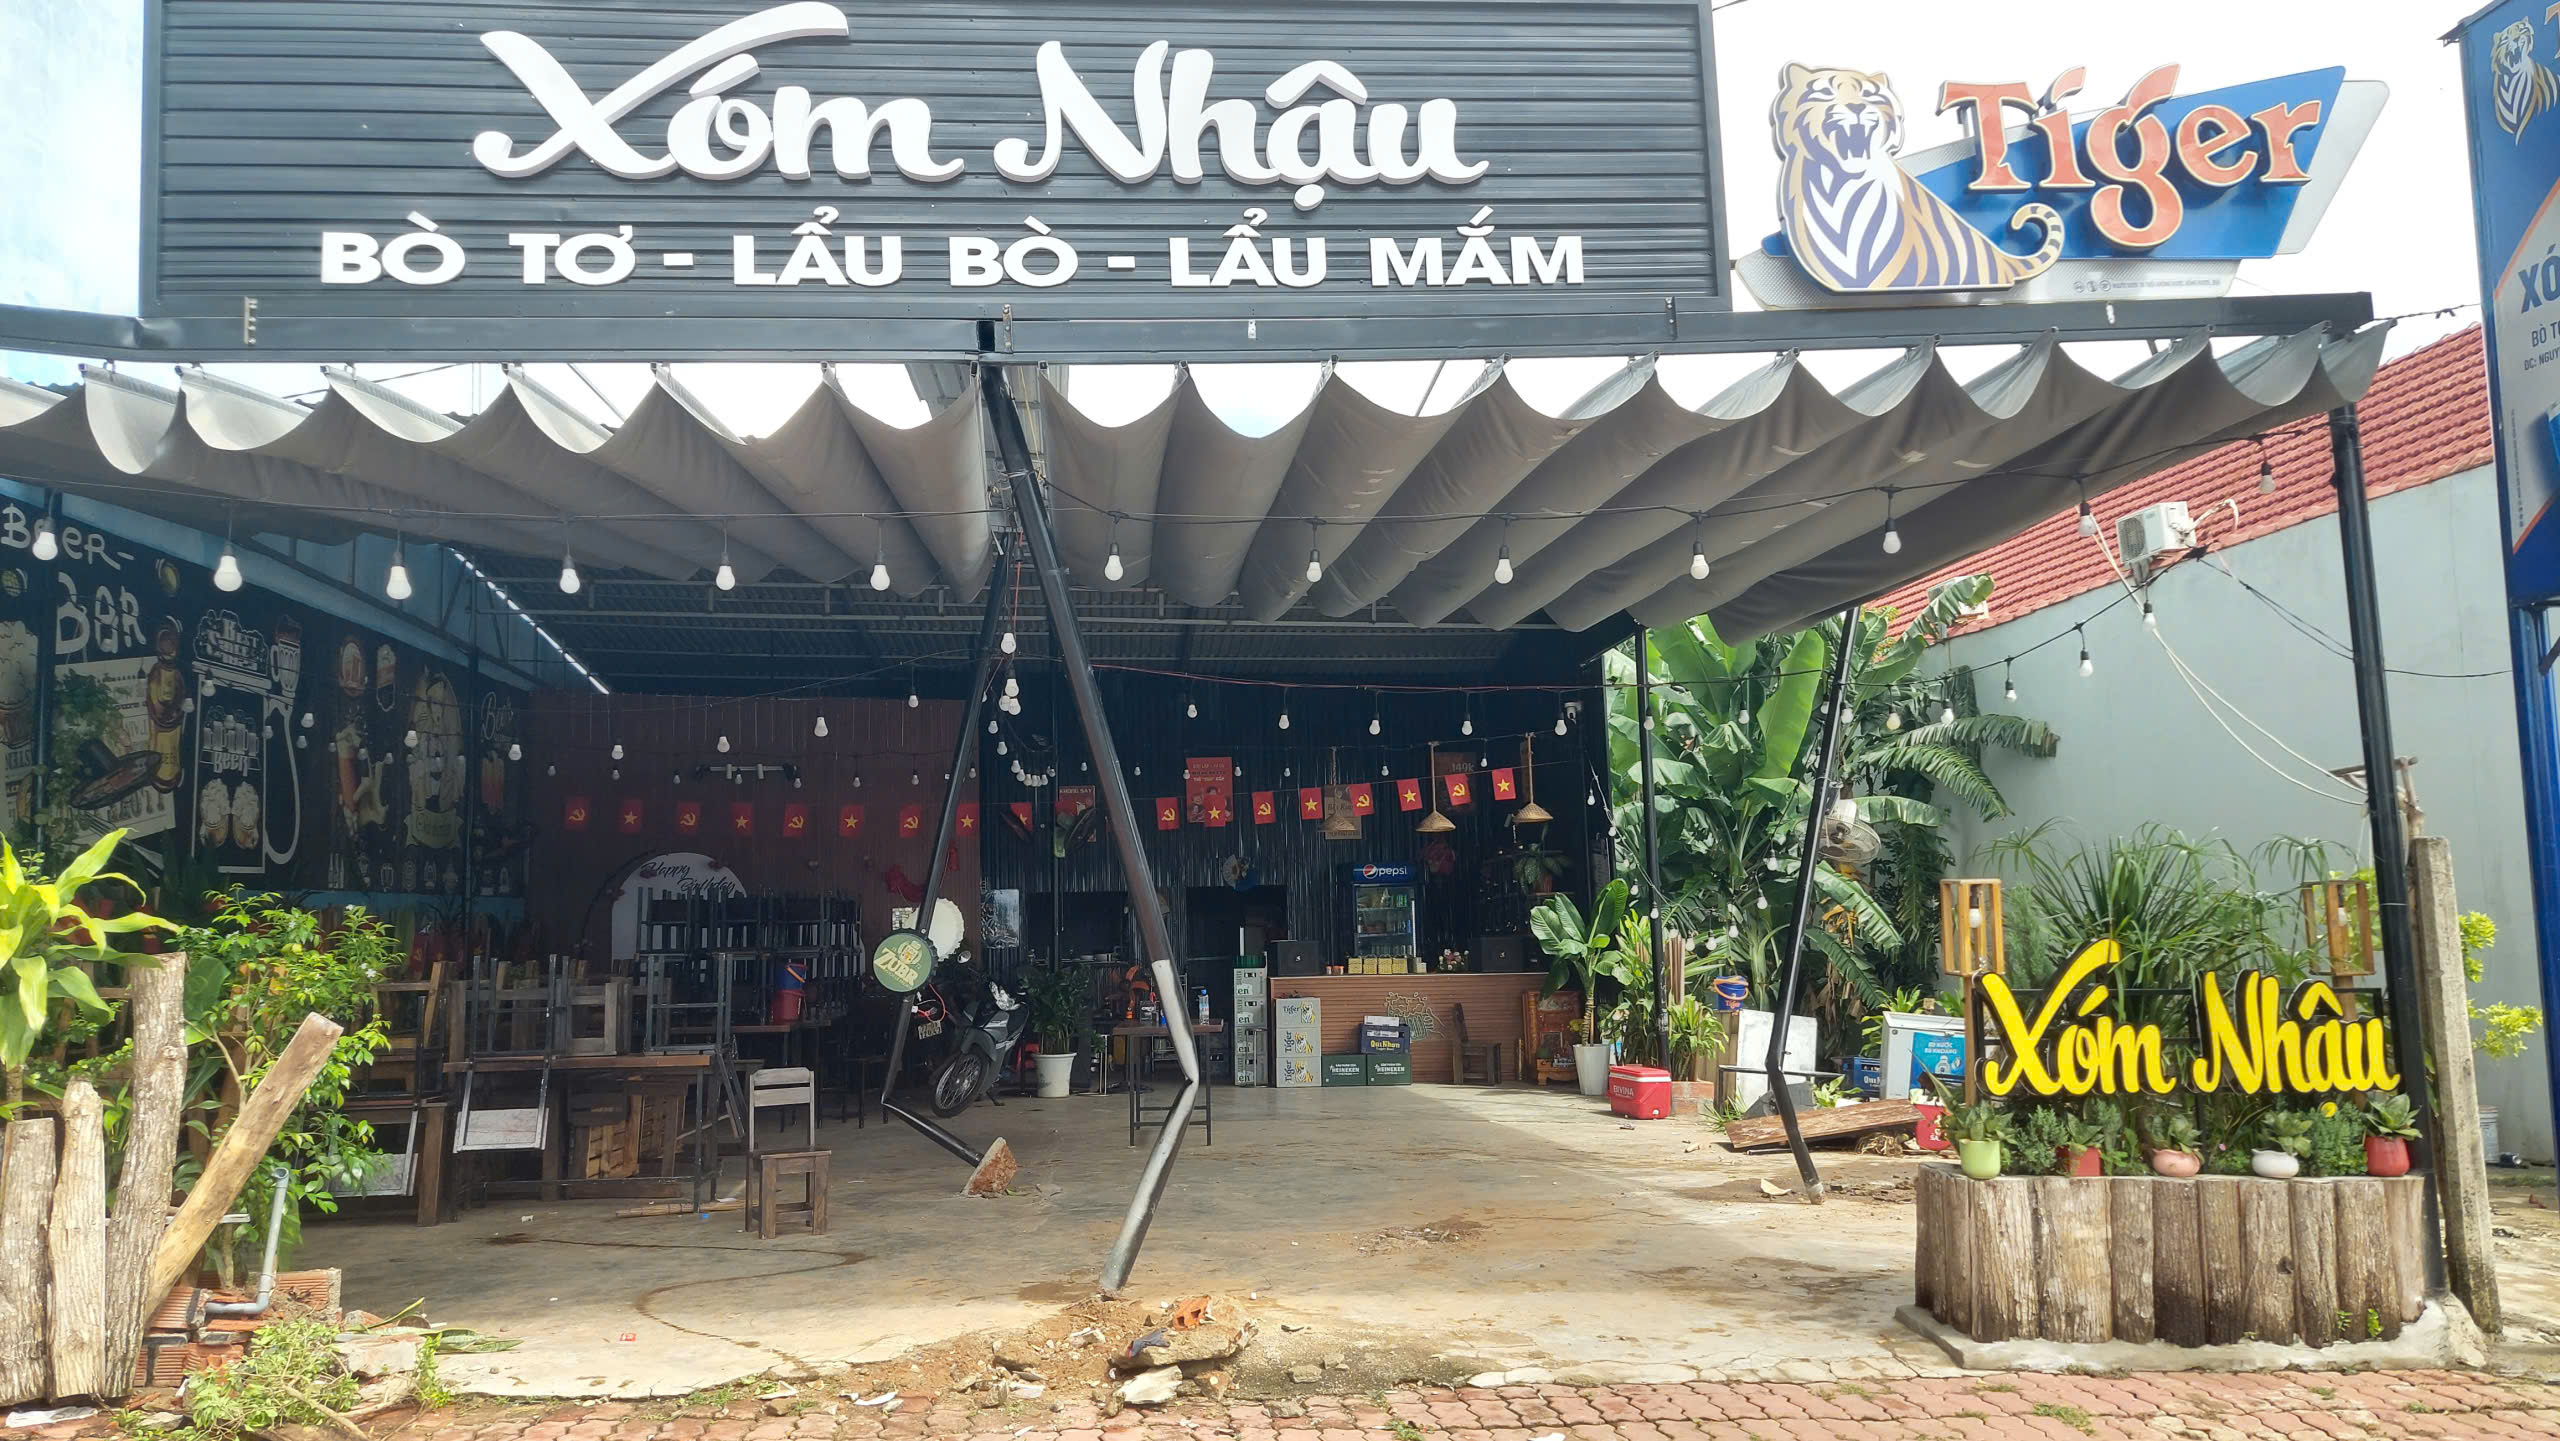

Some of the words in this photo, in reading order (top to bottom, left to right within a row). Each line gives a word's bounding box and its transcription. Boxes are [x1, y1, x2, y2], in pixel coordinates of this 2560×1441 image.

[473, 1, 964, 181] Xóm
[993, 40, 1490, 212] Nhậu
[1936, 64, 2322, 250] Tiger
[321, 211, 465, 284] BÒ
[509, 225, 637, 284] TƠ
[733, 206, 903, 286] LẨU
[950, 216, 1078, 287] BÒ
[1170, 207, 1326, 288] LẨU
[1371, 206, 1584, 287] MẮM
[640, 861, 691, 879] Happy
[1378, 866, 1408, 877] pepsi
[874, 947, 919, 986] ZUBR
[1282, 1005, 1300, 1015] Tiger
[1284, 1031, 1295, 1053] Tiger
[1980, 938, 2176, 1097] Xóm
[2192, 970, 2401, 1118] Nhậu
[1284, 1060, 1295, 1082] Tiger
